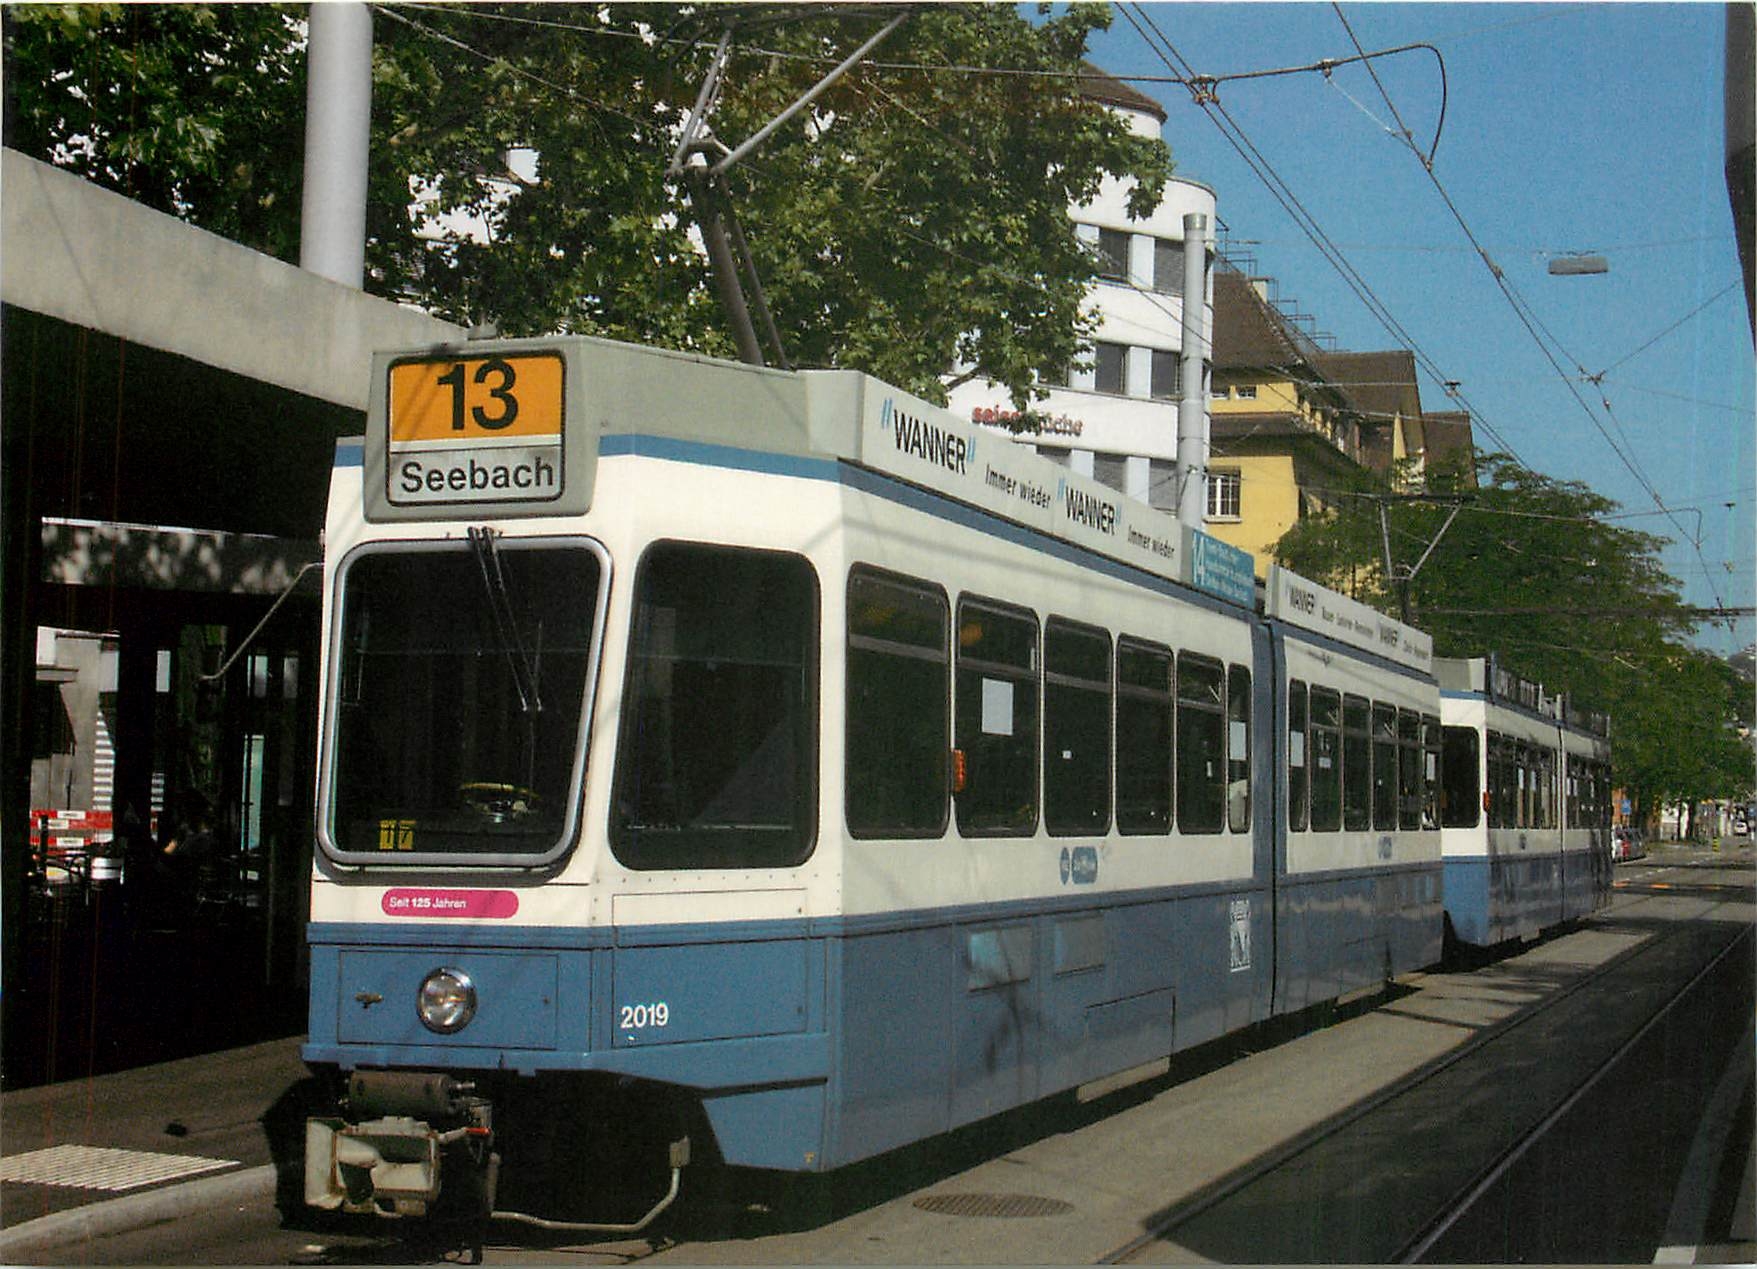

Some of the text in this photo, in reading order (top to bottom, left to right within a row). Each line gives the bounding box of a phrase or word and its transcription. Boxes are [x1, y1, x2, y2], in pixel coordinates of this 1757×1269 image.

[437, 357, 519, 431] 13
[893, 409, 967, 475] WANNER
[401, 456, 553, 493] Seebach
[985, 463, 1051, 510] Immer wieder
[1065, 484, 1116, 536] WANNER
[1151, 536, 1175, 560] wieder
[389, 896, 467, 909] Seit 125 Jahren
[621, 1002, 669, 1029] 2019
